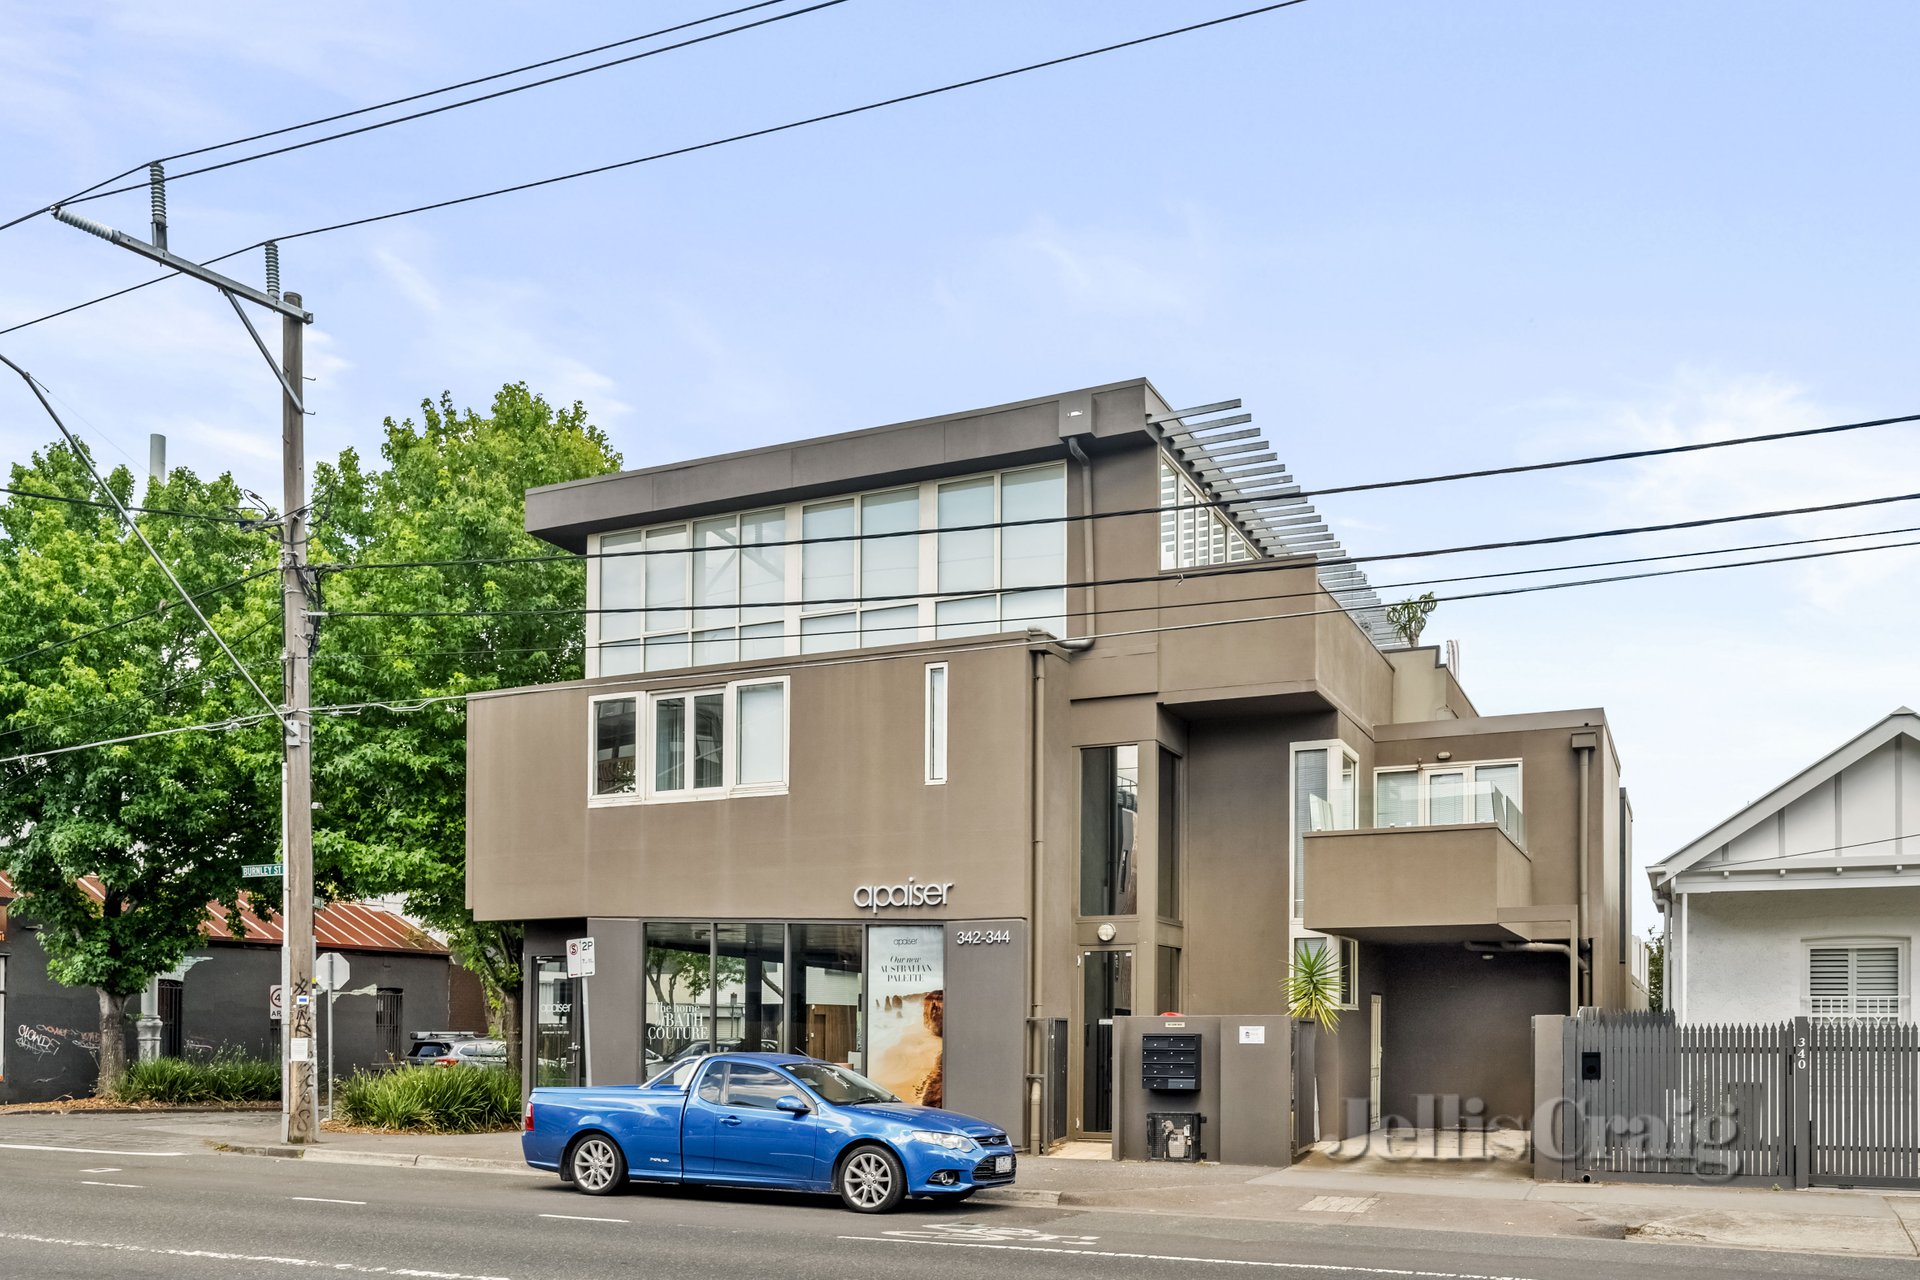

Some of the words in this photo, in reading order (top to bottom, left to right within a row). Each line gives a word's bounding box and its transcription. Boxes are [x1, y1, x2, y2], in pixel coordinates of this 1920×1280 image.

[243, 866, 272, 876] BURNLEY
[273, 865, 282, 874] ST
[853, 876, 954, 914] apaiser
[893, 937, 918, 946] apaiser
[957, 930, 1010, 945] 342-344
[582, 941, 593, 951] 2P
[653, 1001, 672, 1013] The
[674, 1001, 700, 1013] home
[666, 1012, 704, 1028] BATH
[647, 1026, 709, 1041] COUTURE
[1797, 1037, 1806, 1070] 340
